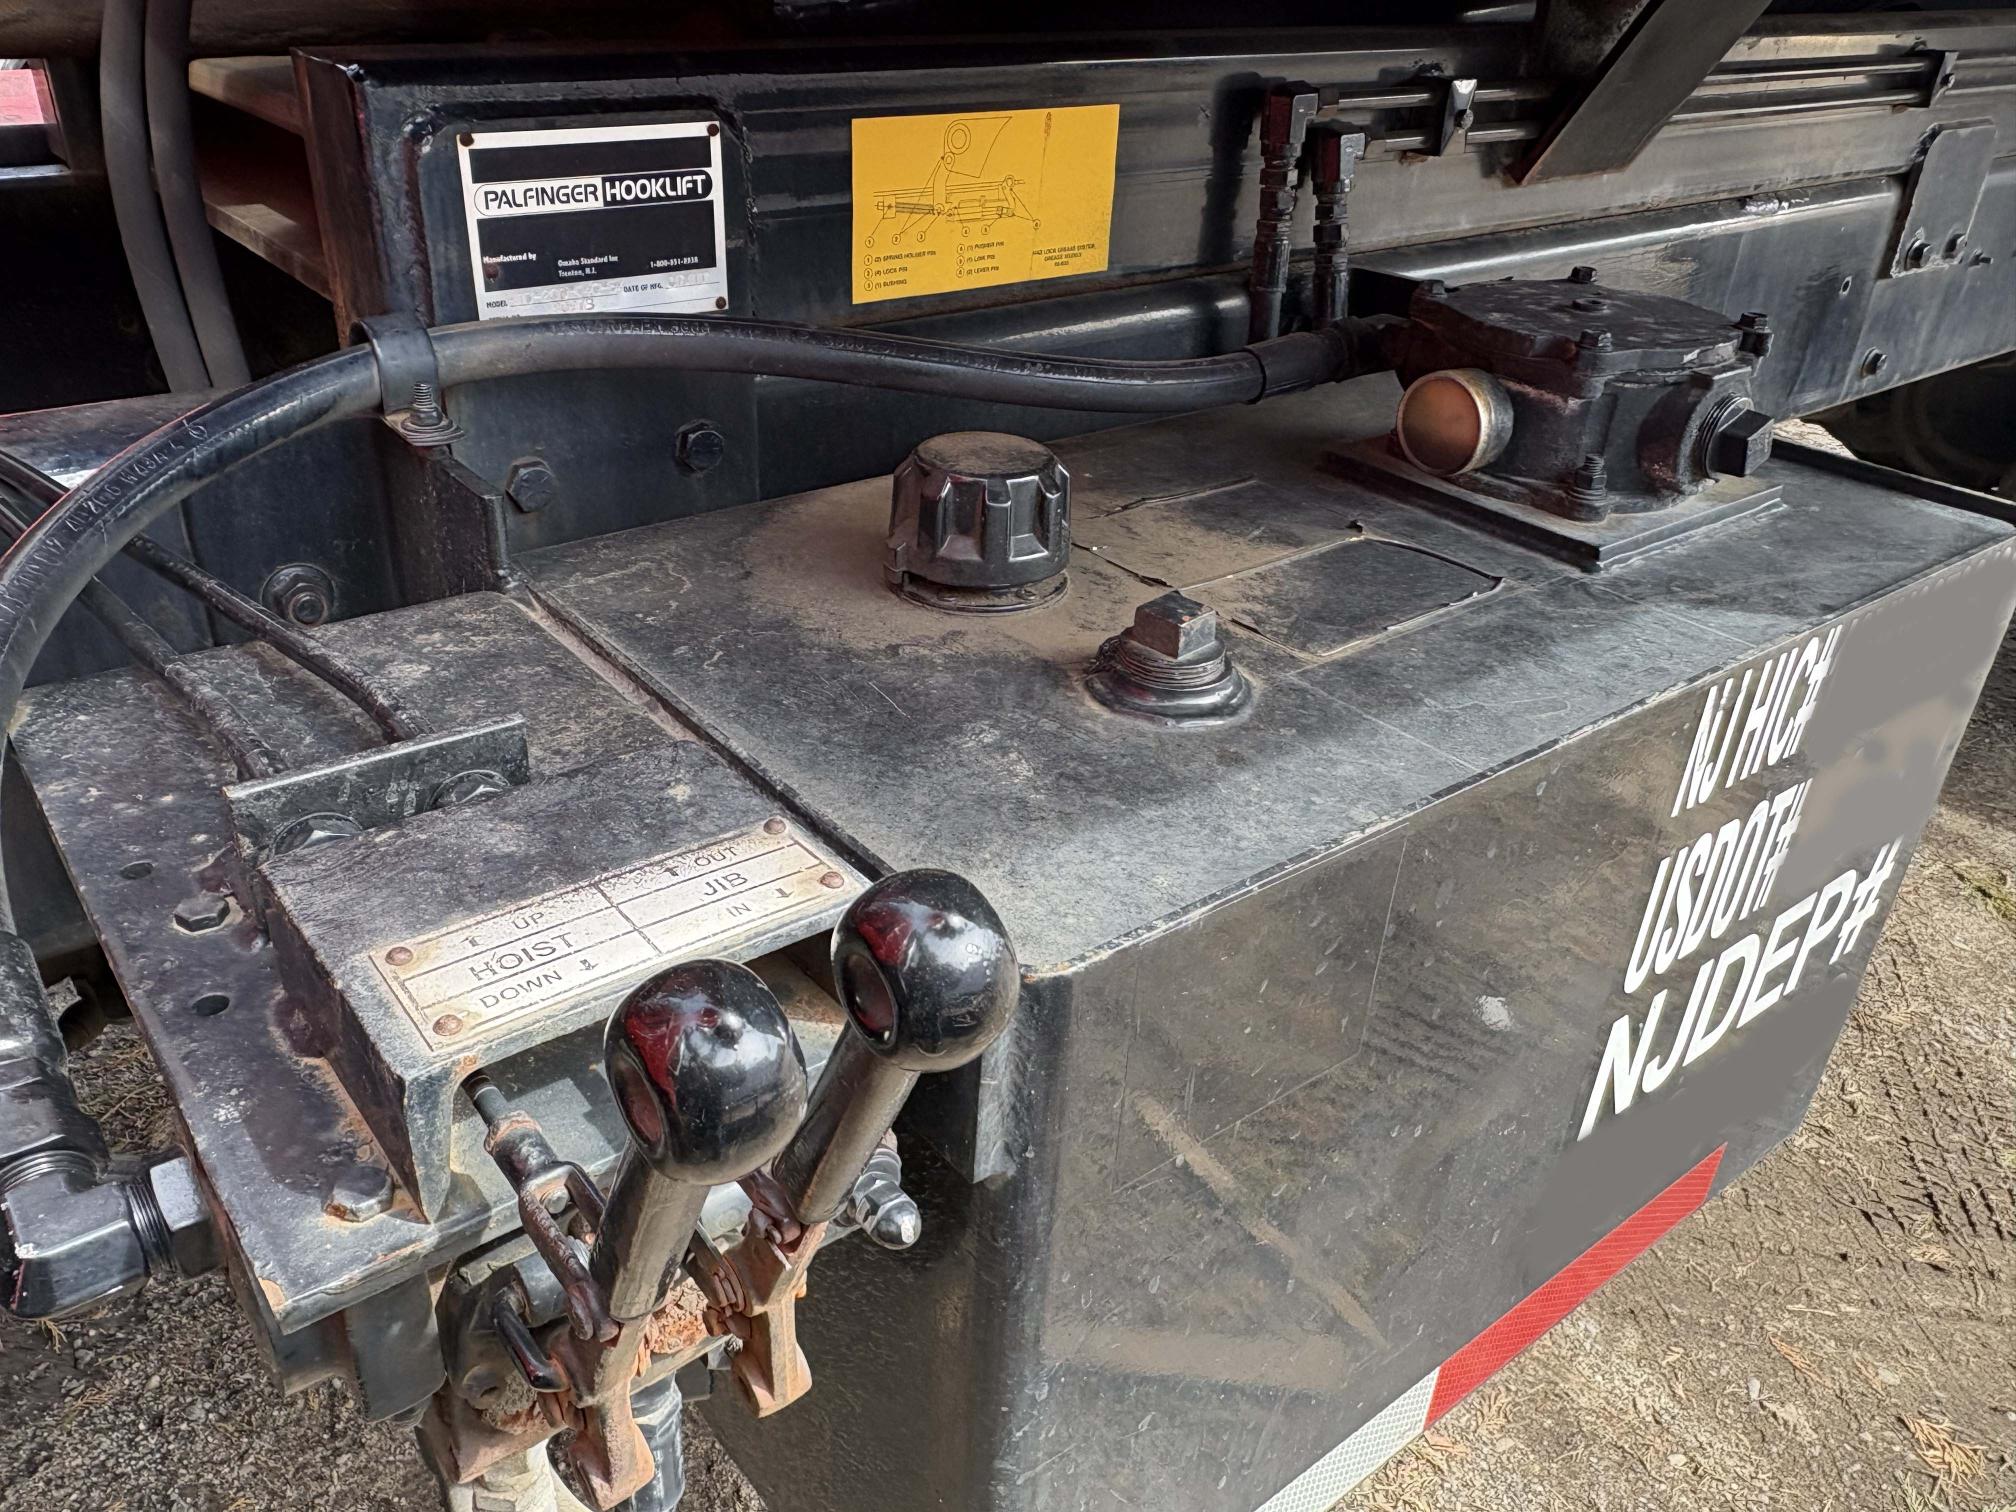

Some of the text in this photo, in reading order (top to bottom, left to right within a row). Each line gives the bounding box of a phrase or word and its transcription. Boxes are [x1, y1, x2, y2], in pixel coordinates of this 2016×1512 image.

[484, 175, 706, 210] PALFINGER HOOKLIFT
[483, 253, 537, 265] Manufactured by
[557, 258, 579, 267] Omaha
[580, 255, 607, 266] Standard
[883, 267, 897, 275] LOCK
[623, 285, 639, 293] DATE
[486, 300, 508, 309] MODEL
[1670, 669, 1753, 818] NJ
[693, 845, 741, 868] OUT
[702, 872, 749, 897] JIB
[1623, 778, 1813, 994] USDOT#
[512, 910, 545, 931] UP
[725, 902, 753, 918] IN
[469, 932, 577, 982] HOIST
[478, 969, 564, 1009] DOWN
[1577, 836, 1904, 1142] NJDEP#
